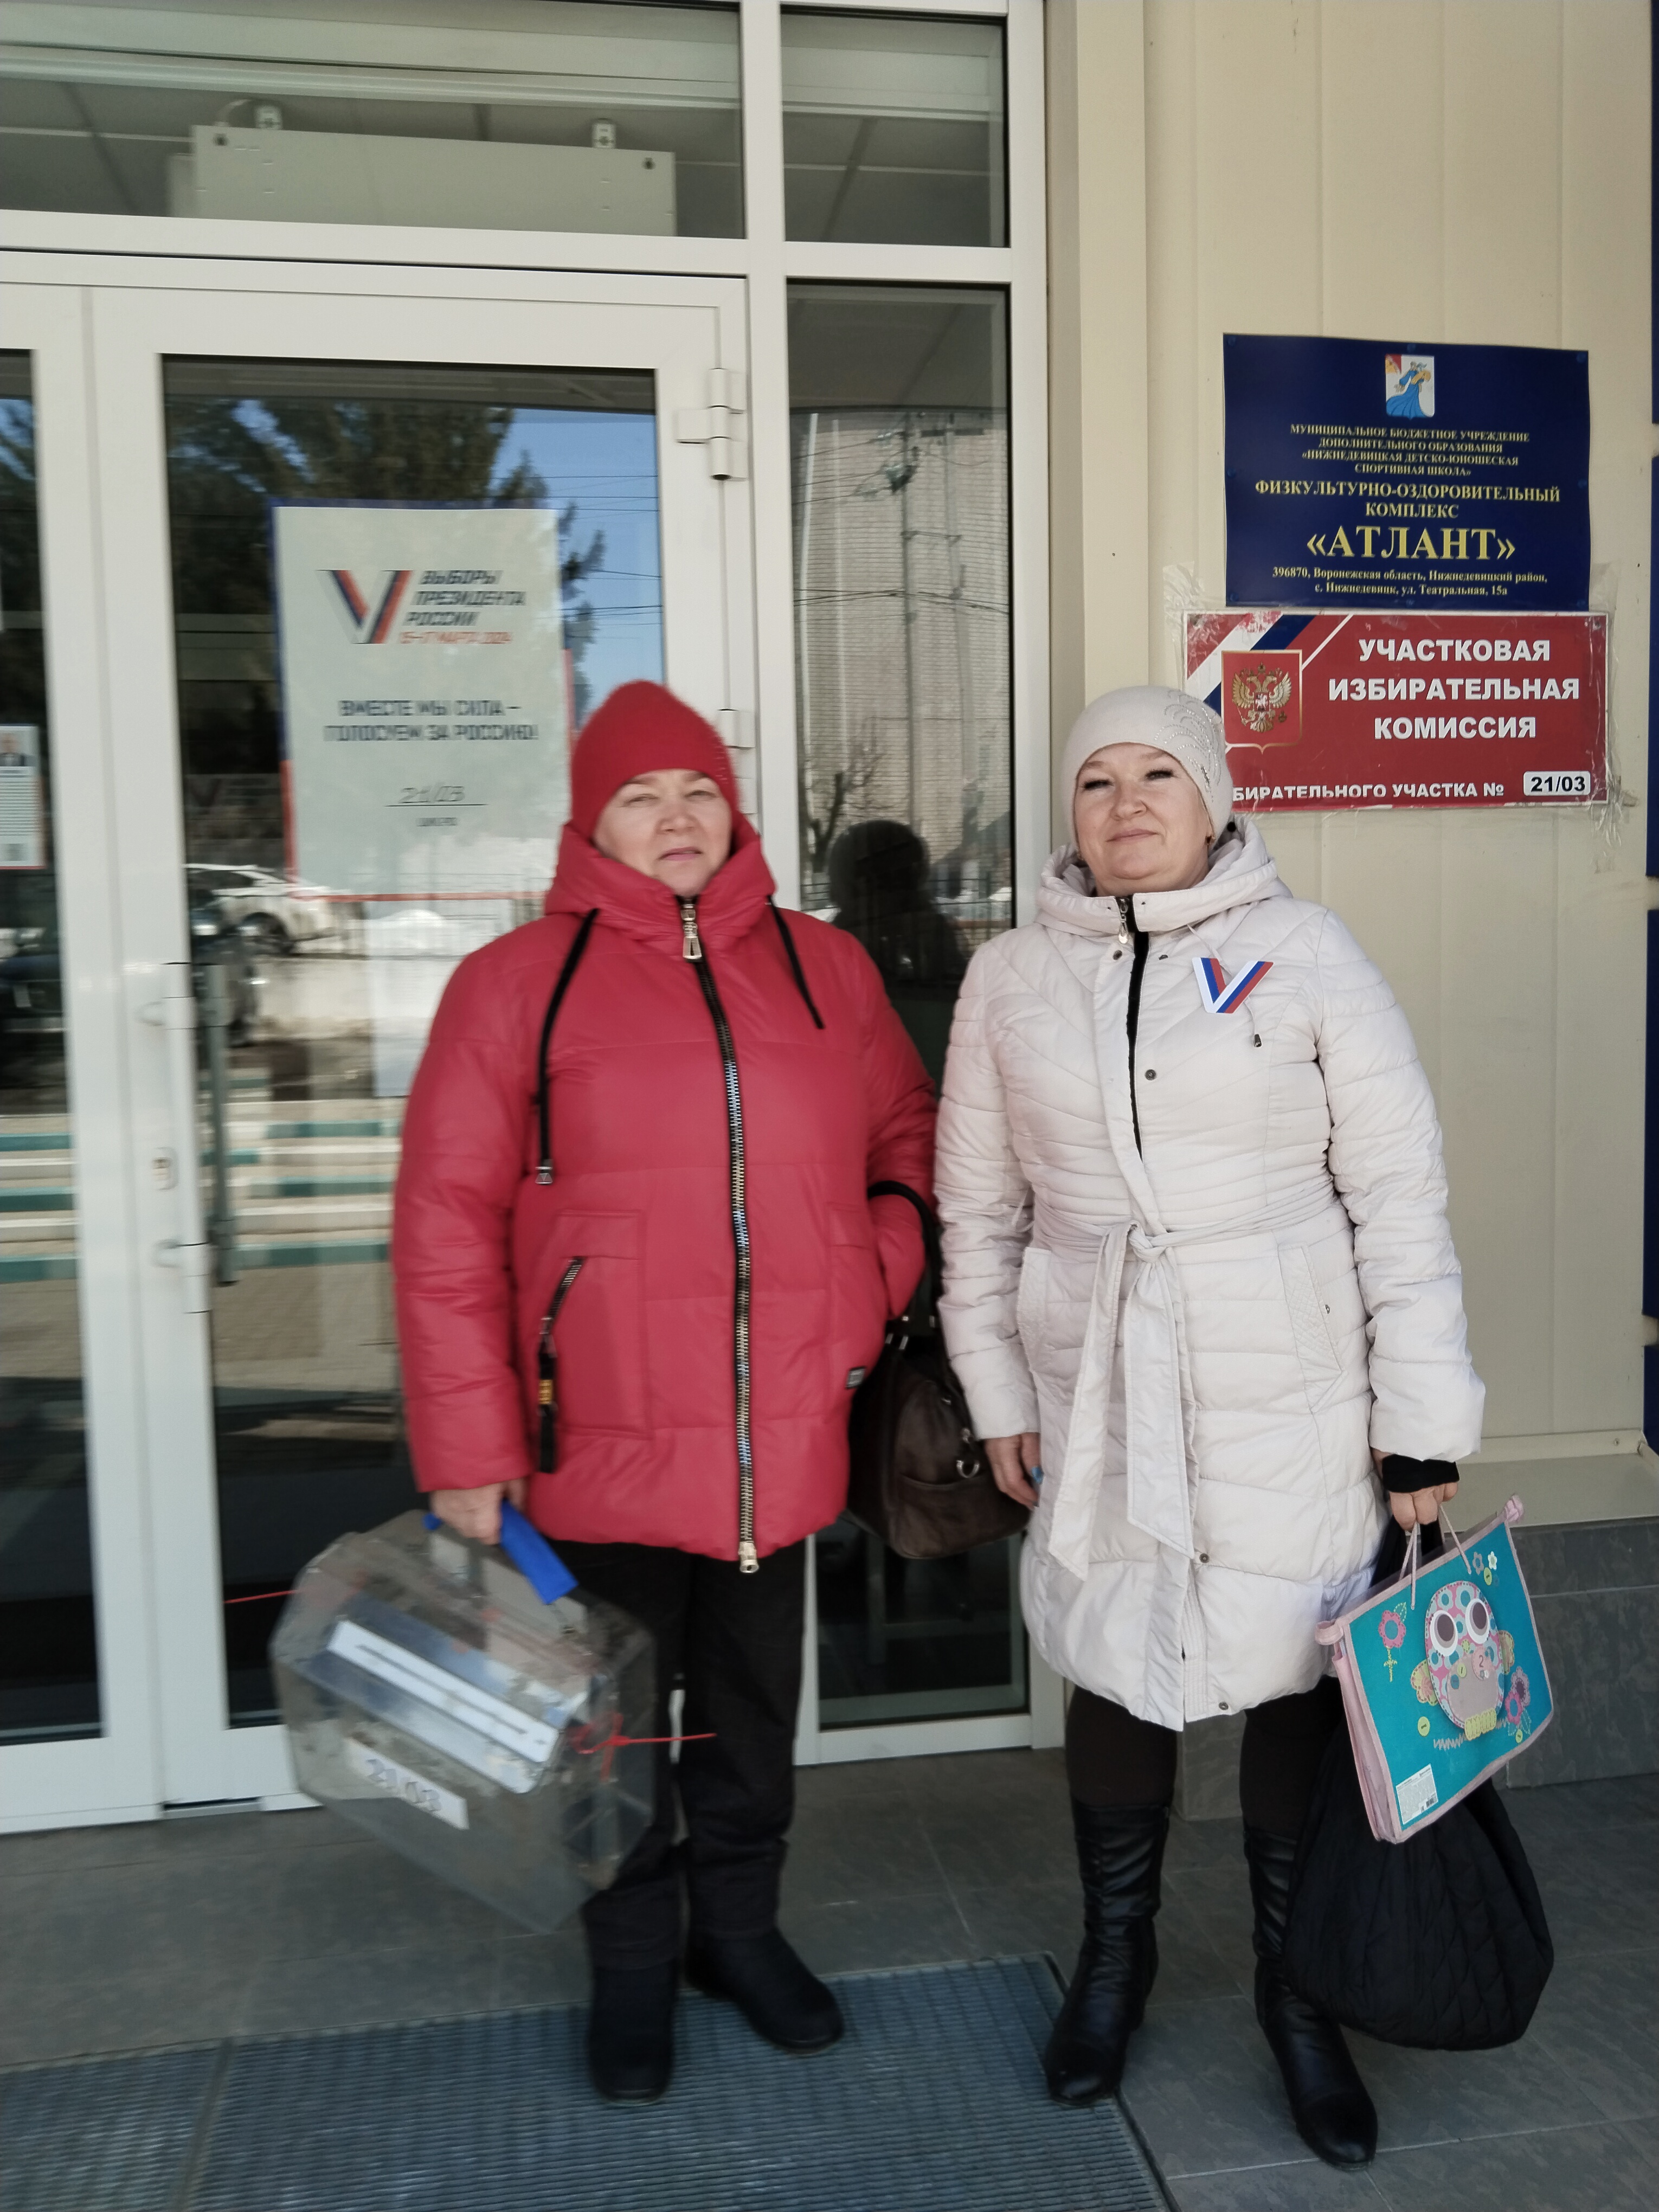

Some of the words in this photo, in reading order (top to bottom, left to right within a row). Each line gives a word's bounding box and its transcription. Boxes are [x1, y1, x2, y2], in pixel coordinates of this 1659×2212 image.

[1290, 424, 1387, 437] МУНИЦИПАЛЬНОЕ
[1390, 427, 1457, 440] БЮДЖЕТНОЕ
[1460, 430, 1530, 442] УЧРЕЖДЕНИЕ
[1319, 437, 1426, 451] ДОПОЛНИТЕЛЬНОГО
[1428, 441, 1503, 453] ОБРАЗОВАНИЯ
[1405, 453, 1519, 466] ДЕТСКО-ЮНОШЕСКАЯ
[1355, 463, 1425, 475] СПОРТИВНАЯ
[1427, 465, 1471, 476] ШКОЛА»
[1255, 480, 1560, 502] ФИЗКУЛЬТУРНО-ОЗДОРОВИТЕЛЬНЫЙ
[1365, 502, 1459, 518] КОМПЛЕКС
[1307, 525, 1516, 560] «АТЛАНТ»
[1272, 567, 1310, 580] 396870,
[1314, 567, 1381, 581] Воронежская
[1384, 569, 1426, 581] область,
[1515, 572, 1548, 584] район,
[1419, 584, 1489, 597] Театральная,
[1358, 639, 1551, 662] УЧАСТКОВАЯ
[1328, 678, 1579, 700] ИЗБИРАТЕЛЬНАЯ
[1374, 716, 1536, 740] КОМИССИЯ
[1232, 784, 1386, 801] БИРАТЕЛЬНОГО
[1391, 782, 1478, 798] УЧАСТКА
[1483, 782, 1504, 796] №
[1531, 775, 1586, 793] 21/03
